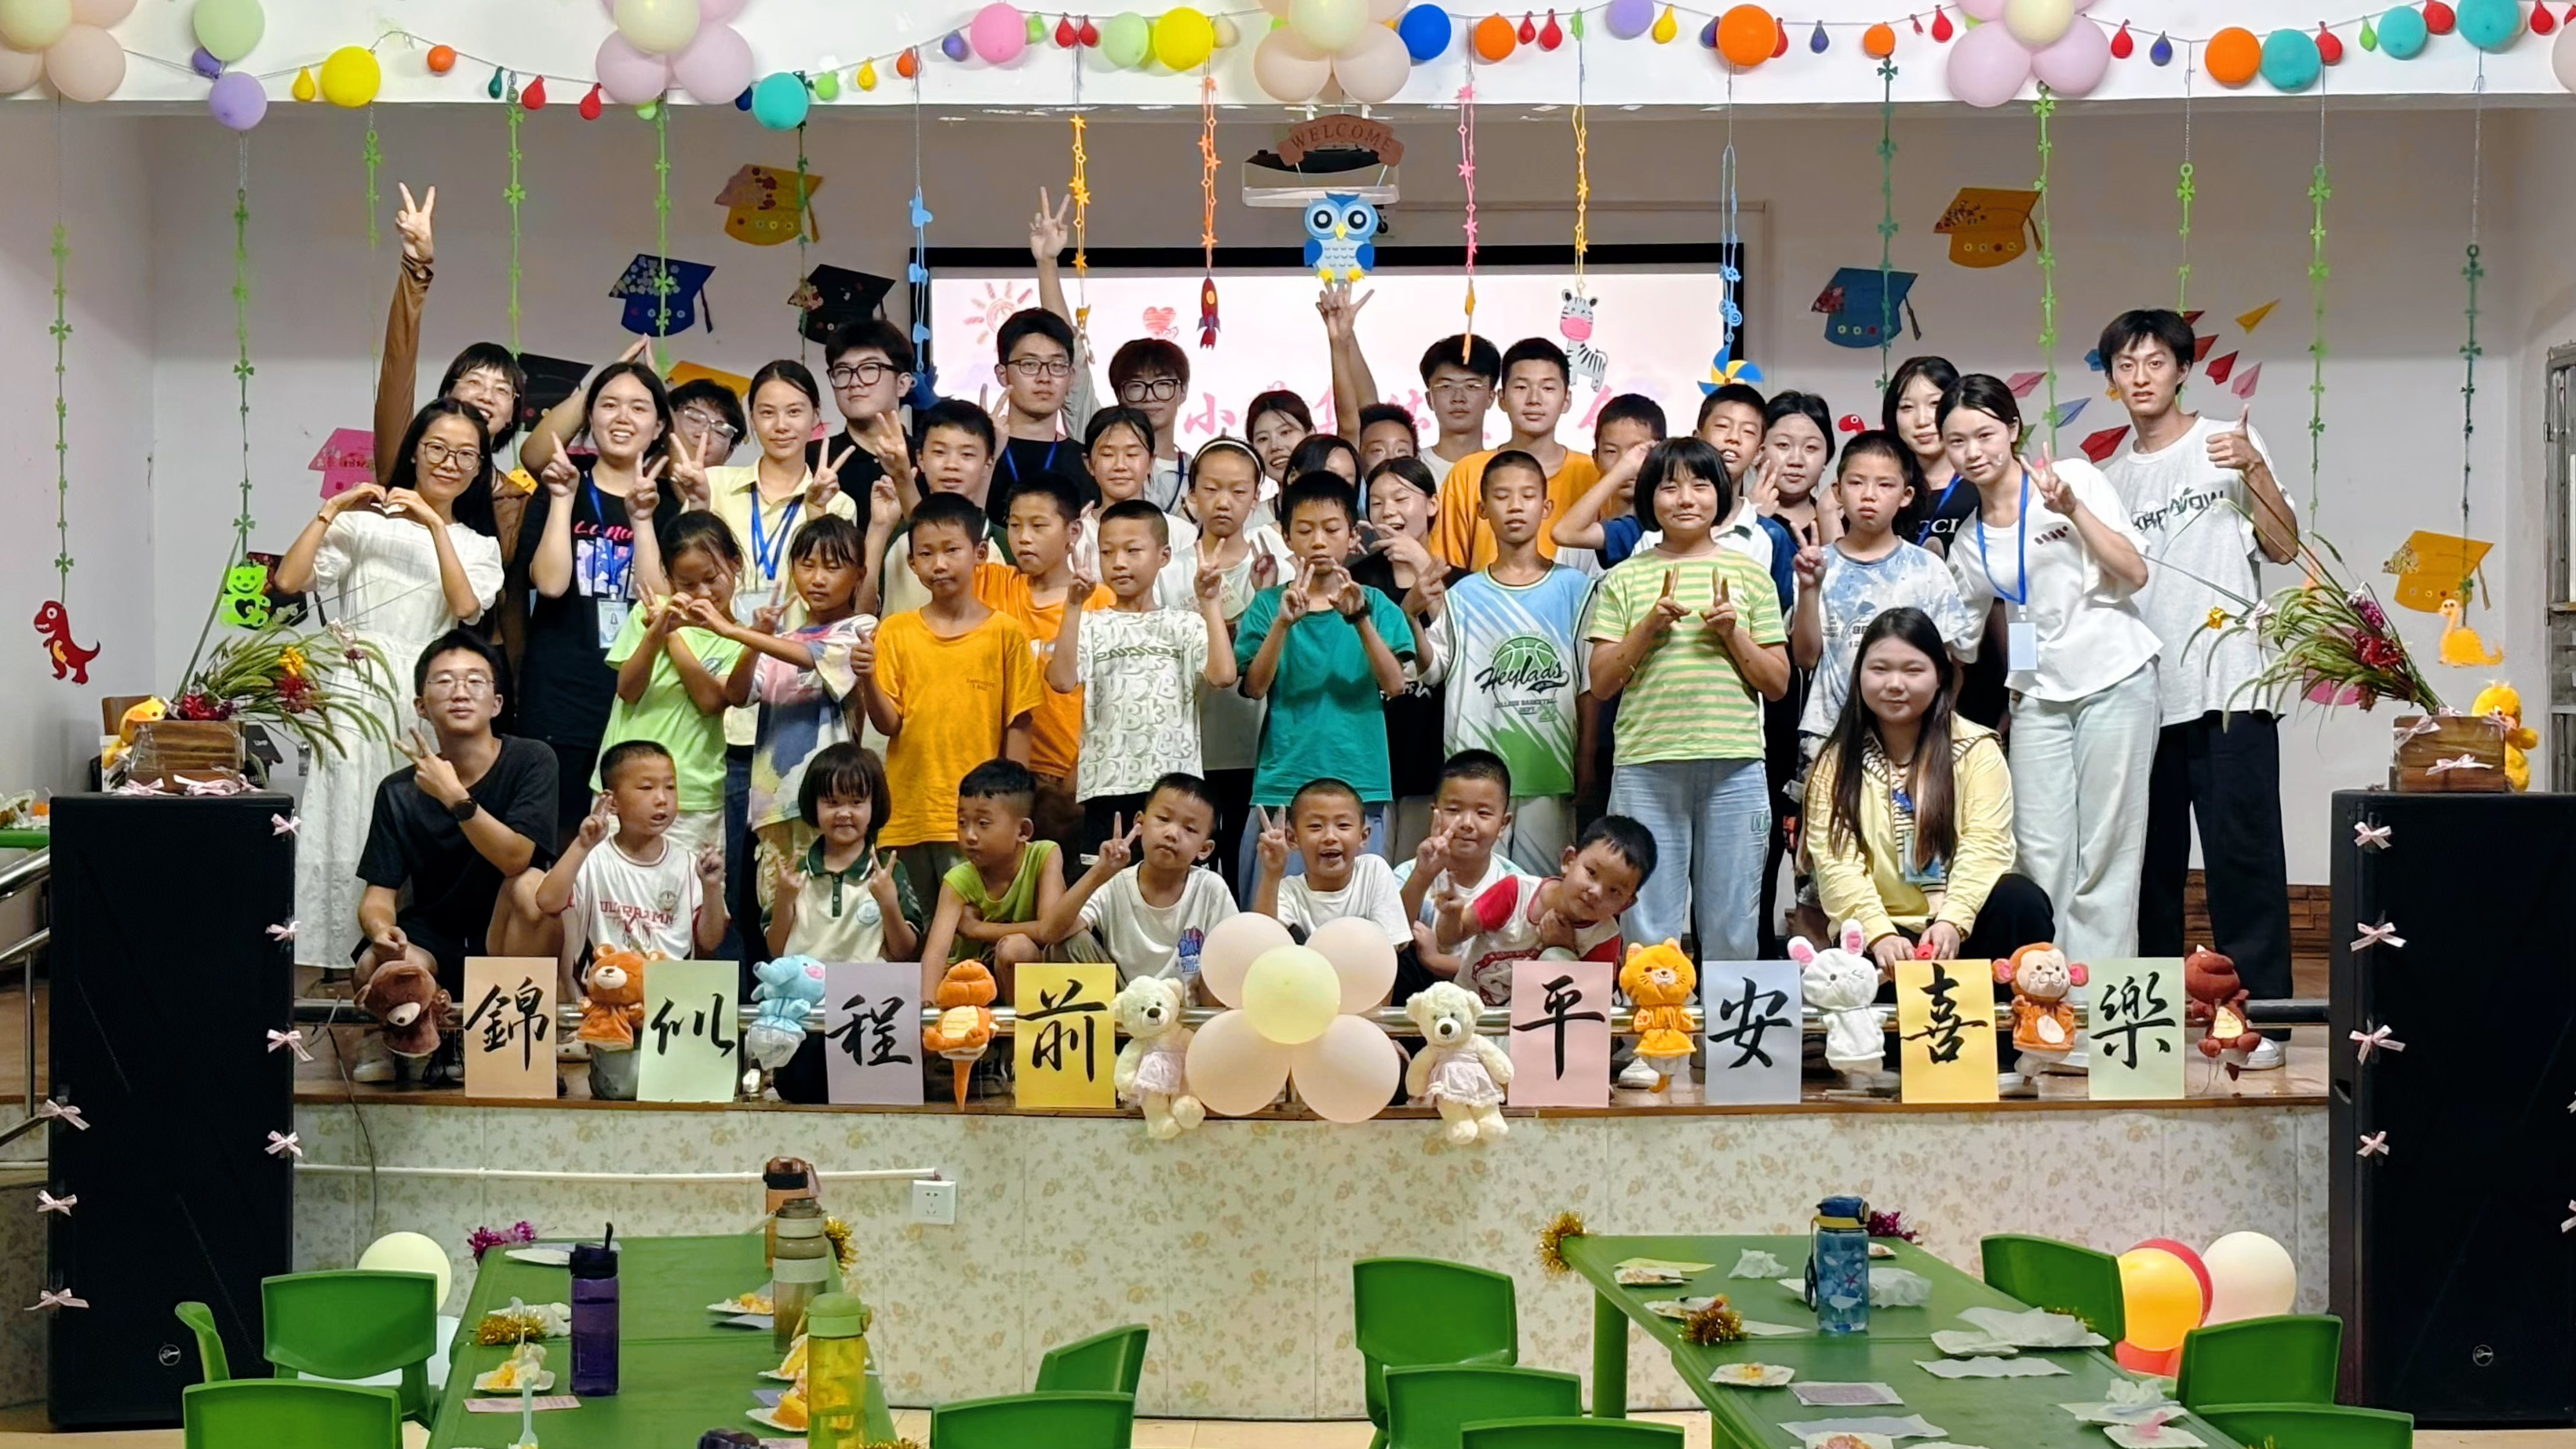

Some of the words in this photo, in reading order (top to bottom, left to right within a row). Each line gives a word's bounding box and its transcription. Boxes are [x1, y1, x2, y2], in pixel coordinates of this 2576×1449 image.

[1291, 122, 1393, 153] WELCOME
[1474, 655, 1564, 694] Heylads
[650, 993, 736, 1057] 似
[825, 995, 913, 1065] 程
[1016, 979, 1107, 1082] 前
[1513, 975, 1605, 1080] 平
[1707, 977, 1791, 1069] 安
[1901, 963, 1988, 1064] 喜
[2090, 971, 2176, 1069] 樂
